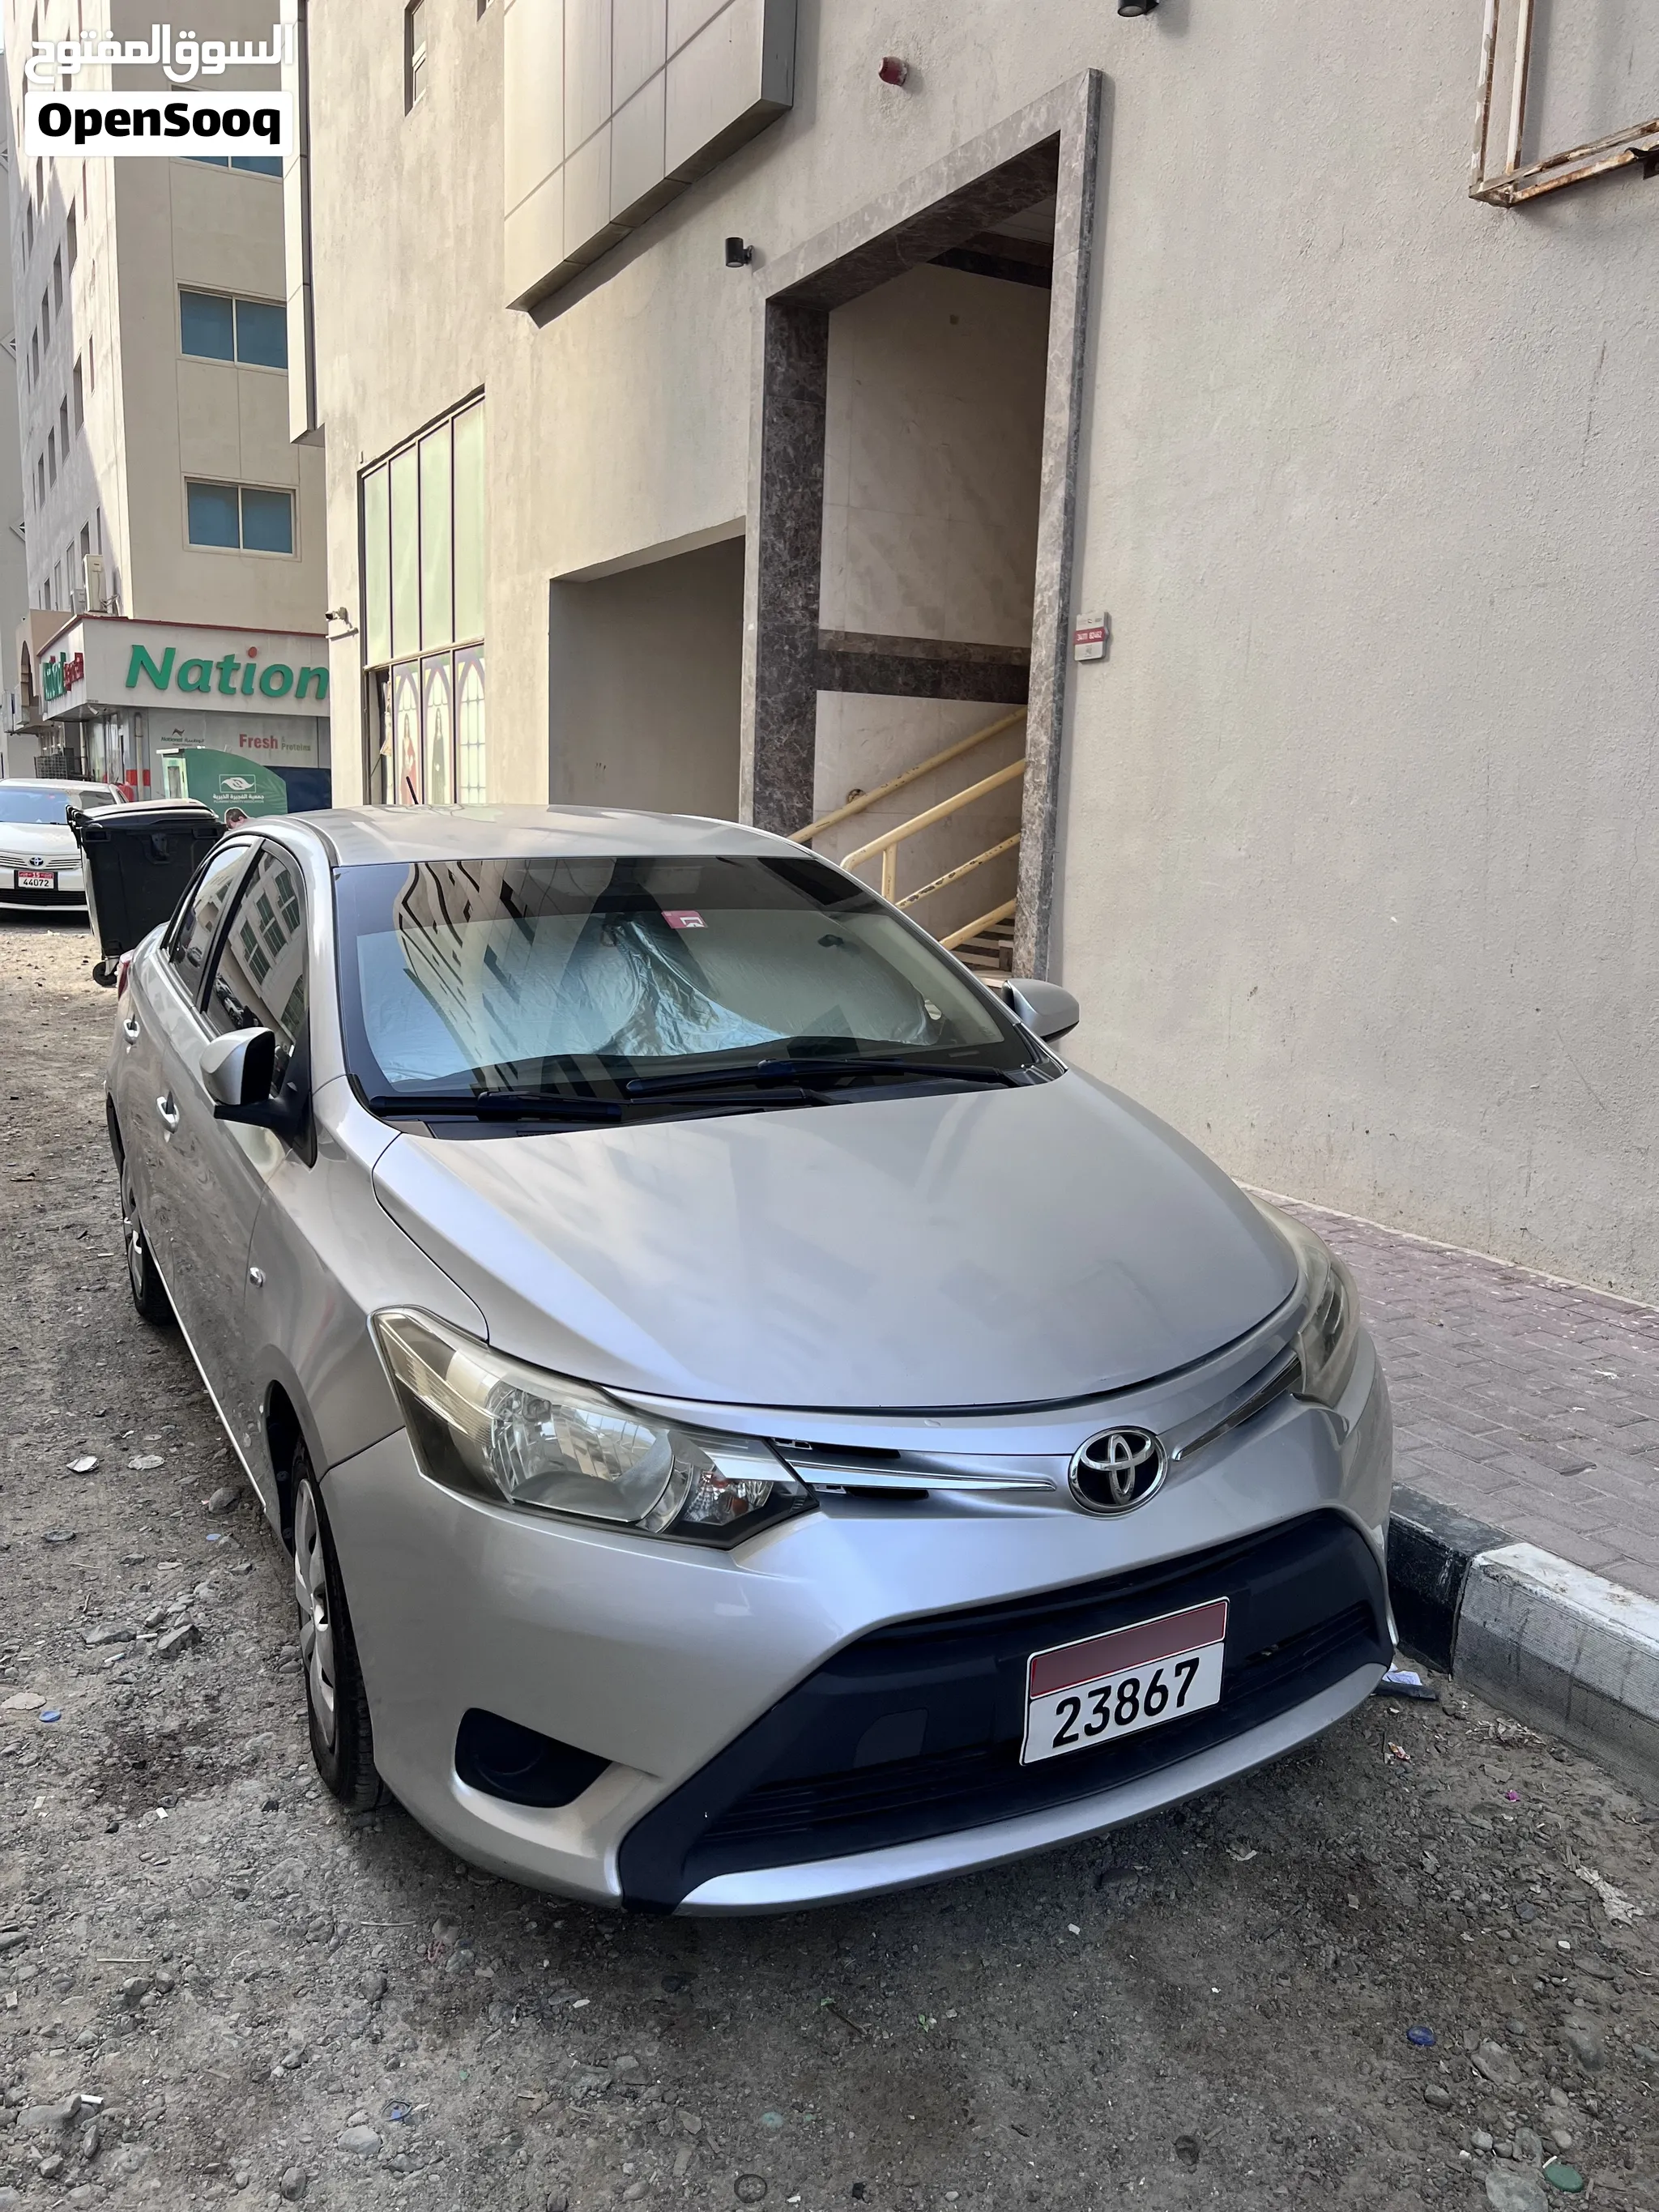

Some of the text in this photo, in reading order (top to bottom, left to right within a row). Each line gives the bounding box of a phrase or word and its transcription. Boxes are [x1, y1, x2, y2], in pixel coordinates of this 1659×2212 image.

[239, 734, 279, 749] Fresh
[281, 743, 311, 752] Proteins
[23, 879, 49, 887] 44072
[1052, 1657, 1200, 1749] 23867
